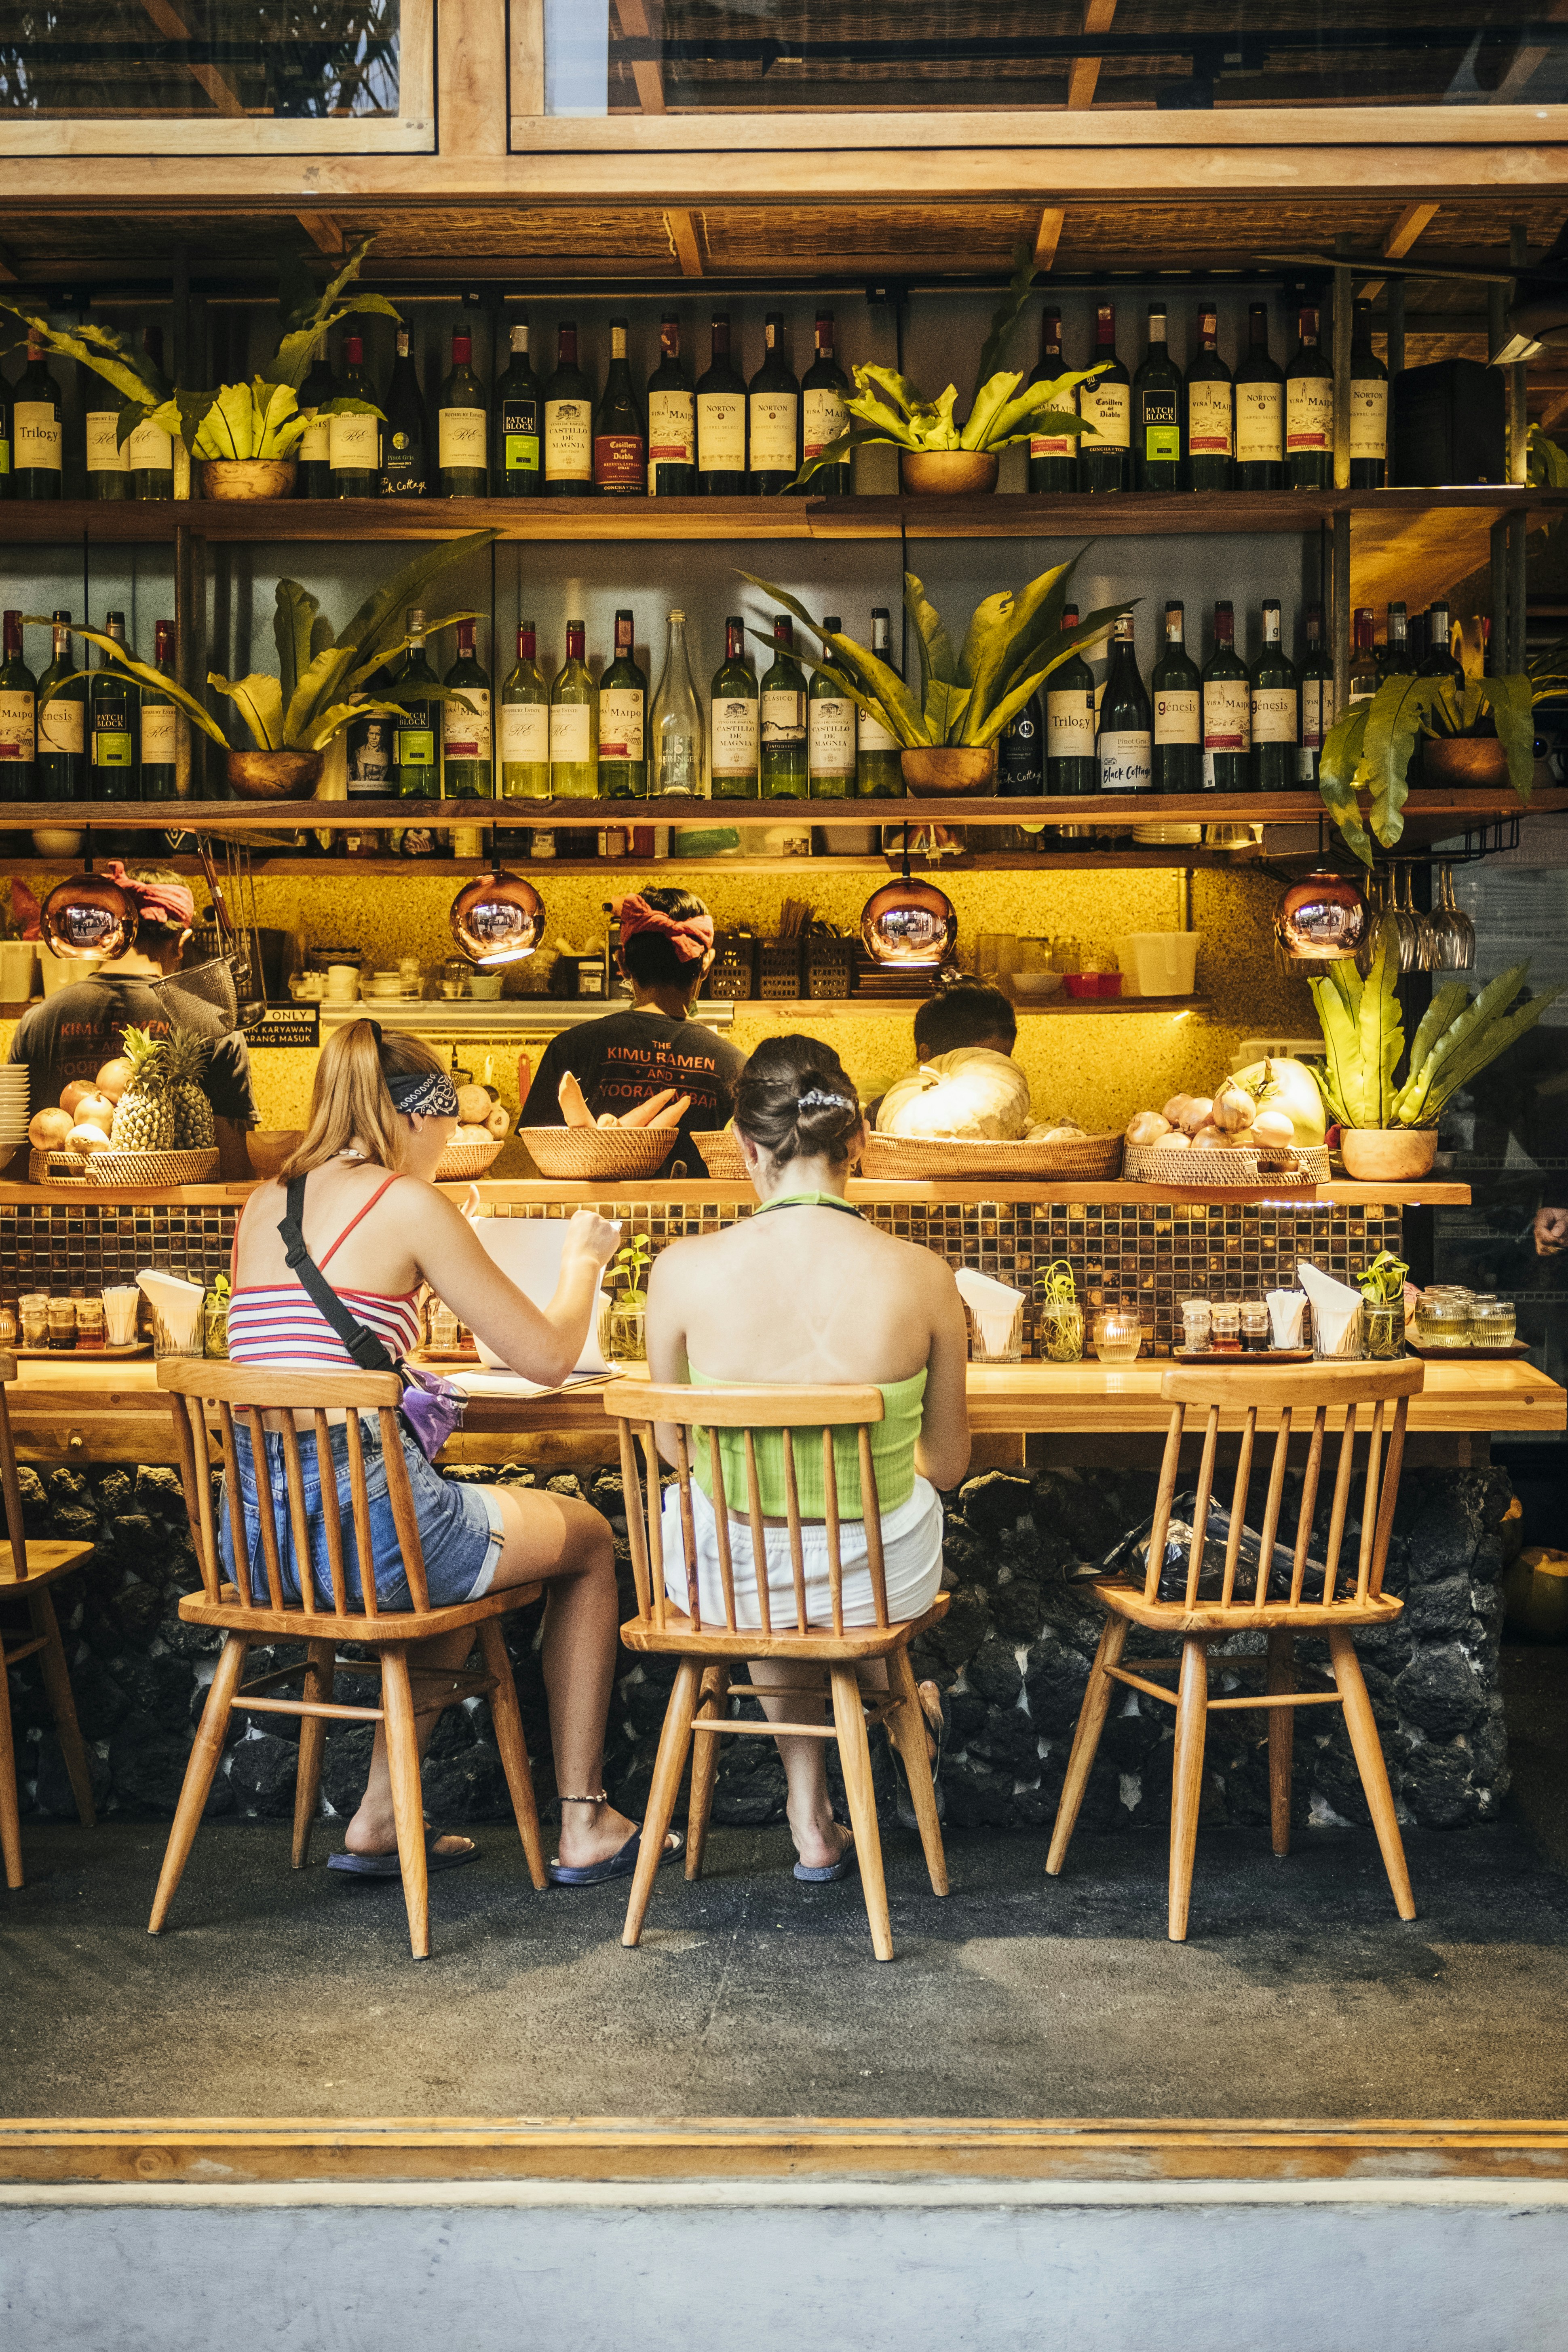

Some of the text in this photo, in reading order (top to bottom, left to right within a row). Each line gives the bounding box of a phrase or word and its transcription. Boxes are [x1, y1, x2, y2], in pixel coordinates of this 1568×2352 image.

[20, 427, 58, 442] Trilogy
[397, 479, 426, 494] Cottage
[1158, 700, 1196, 715] génesis
[1251, 698, 1288, 714] génesis
[39, 709, 72, 722] énesis
[611, 709, 641, 718] MAIPO
[1052, 715, 1090, 729] Trilogy
[1104, 767, 1124, 783] Black
[272, 1011, 307, 1020] ONLY
[652, 1040, 671, 1049] THE
[608, 1047, 715, 1070] KIMU RAMEN
[648, 1068, 673, 1081] AND
[599, 1084, 654, 1097] YOORA
